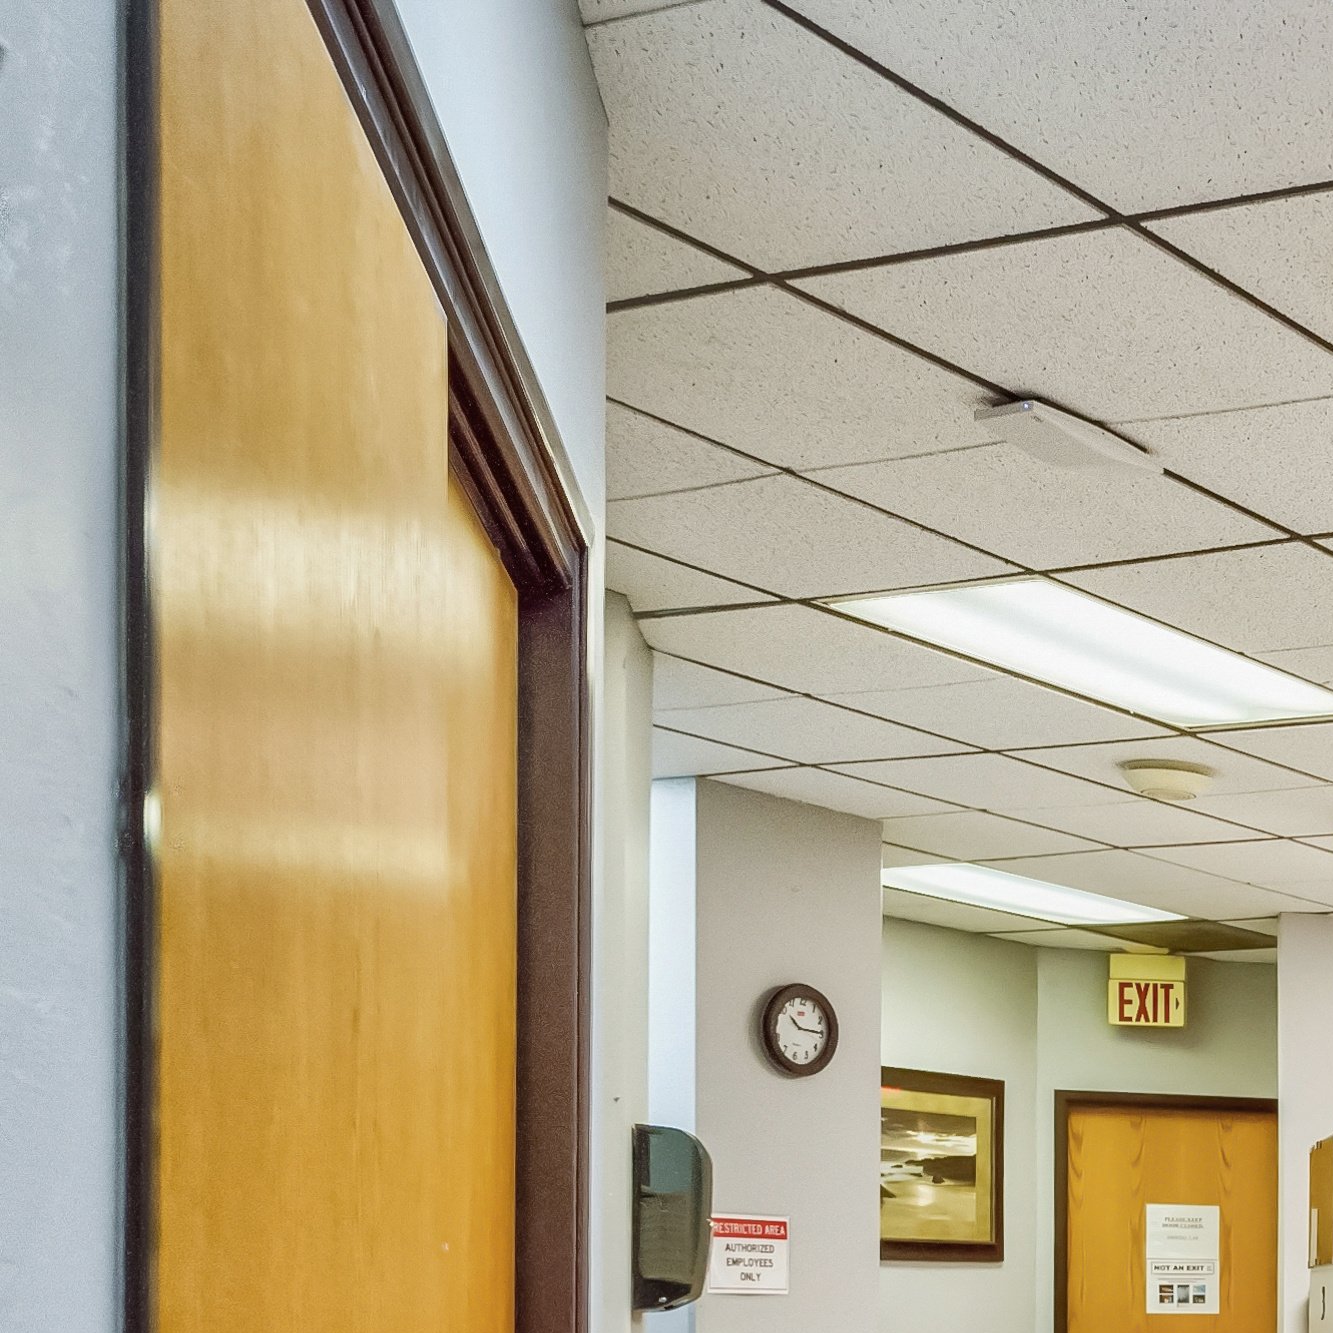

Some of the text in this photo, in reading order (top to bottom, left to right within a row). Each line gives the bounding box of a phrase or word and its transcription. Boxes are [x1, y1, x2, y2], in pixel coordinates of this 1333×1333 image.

[1118, 982, 1174, 1023] EXIT
[713, 1222, 786, 1236] RESTRICTED AREA
[724, 1243, 775, 1254] AUTHORIZED
[726, 1257, 774, 1268] EMPLOYEES
[739, 1271, 762, 1282] ONLY
